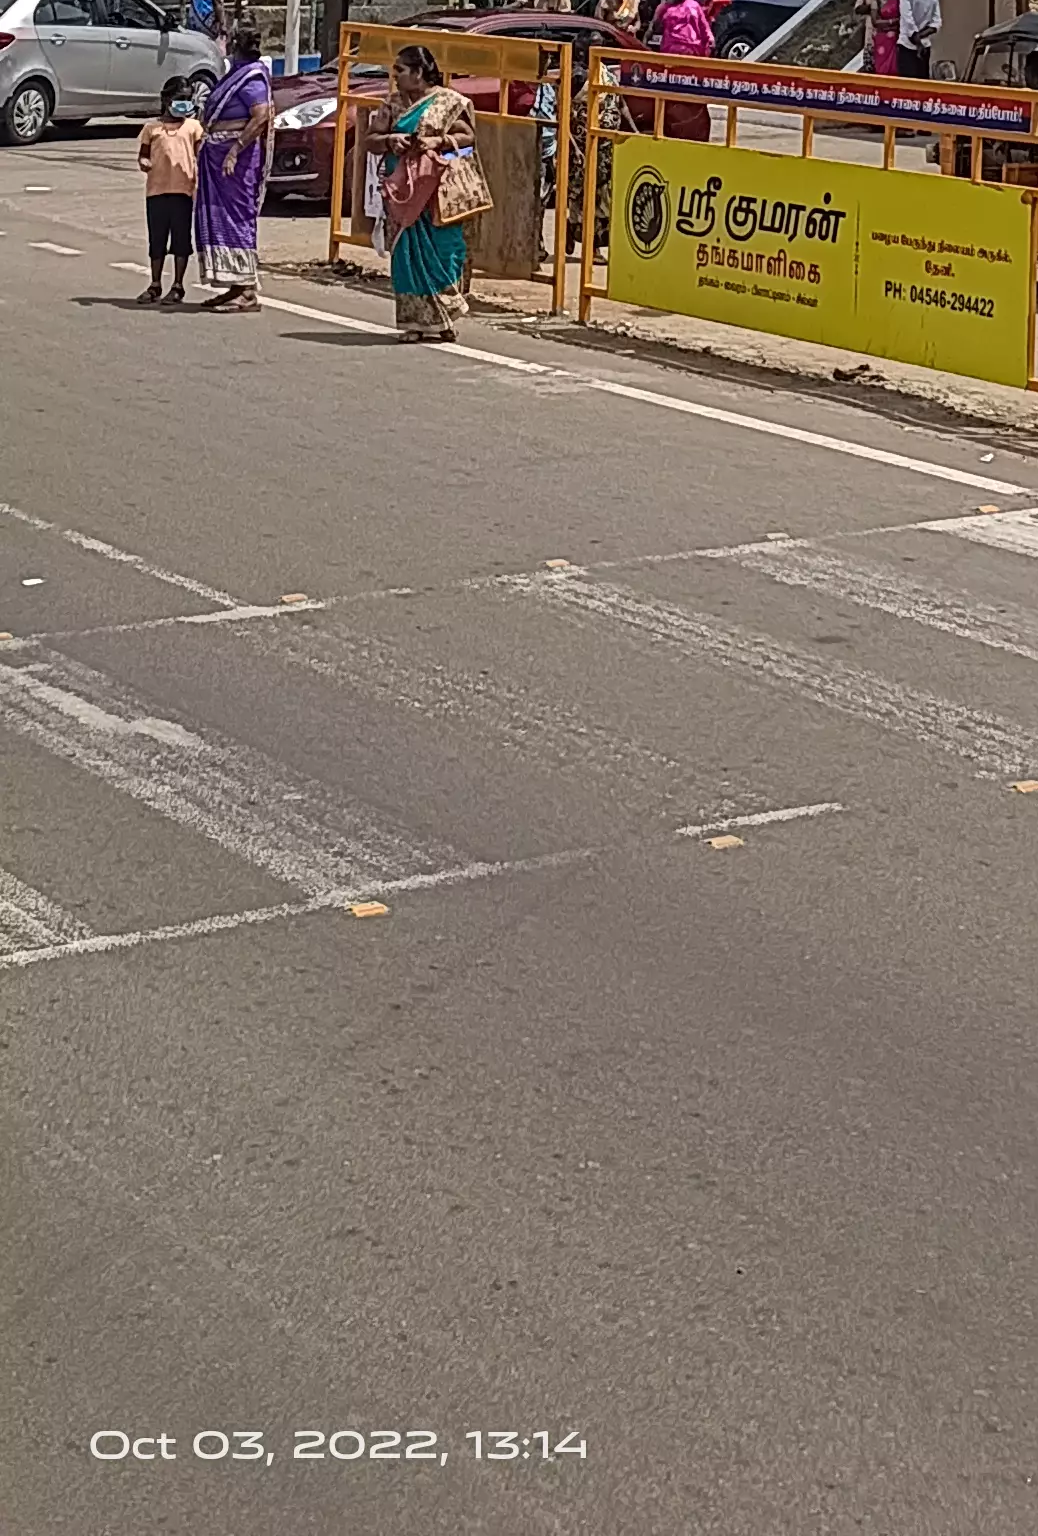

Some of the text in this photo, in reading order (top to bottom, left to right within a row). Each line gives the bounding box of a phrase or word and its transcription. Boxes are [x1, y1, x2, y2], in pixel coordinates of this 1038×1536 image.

[702, 75, 730, 90] காவல்
[805, 85, 836, 101] காவல்
[836, 87, 880, 106] நிலையம்
[725, 192, 846, 243] குமரன்
[696, 237, 821, 284] தங்கமாளிகை
[885, 280, 994, 318] PH: 04546-294422
